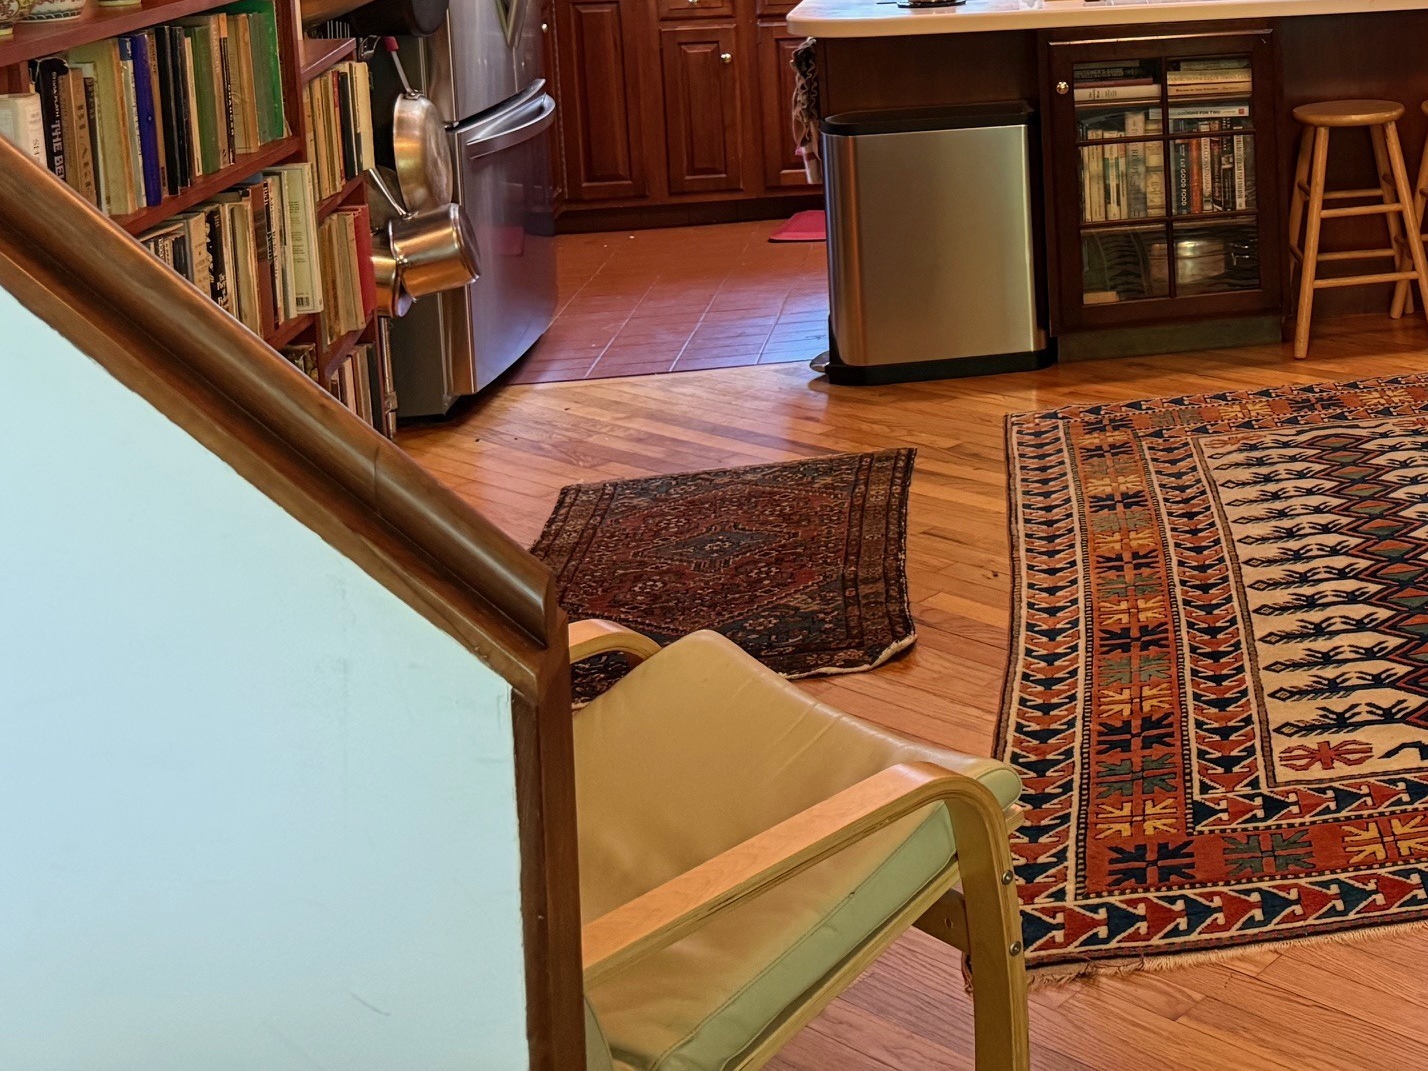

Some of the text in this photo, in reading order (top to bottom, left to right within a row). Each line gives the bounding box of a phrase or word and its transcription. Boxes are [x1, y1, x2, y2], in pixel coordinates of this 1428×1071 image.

[212, 24, 220, 74] CHAUCER
[227, 84, 235, 136] CHAUCER
[51, 121, 63, 153] THE
[77, 104, 96, 198] BLAKE
